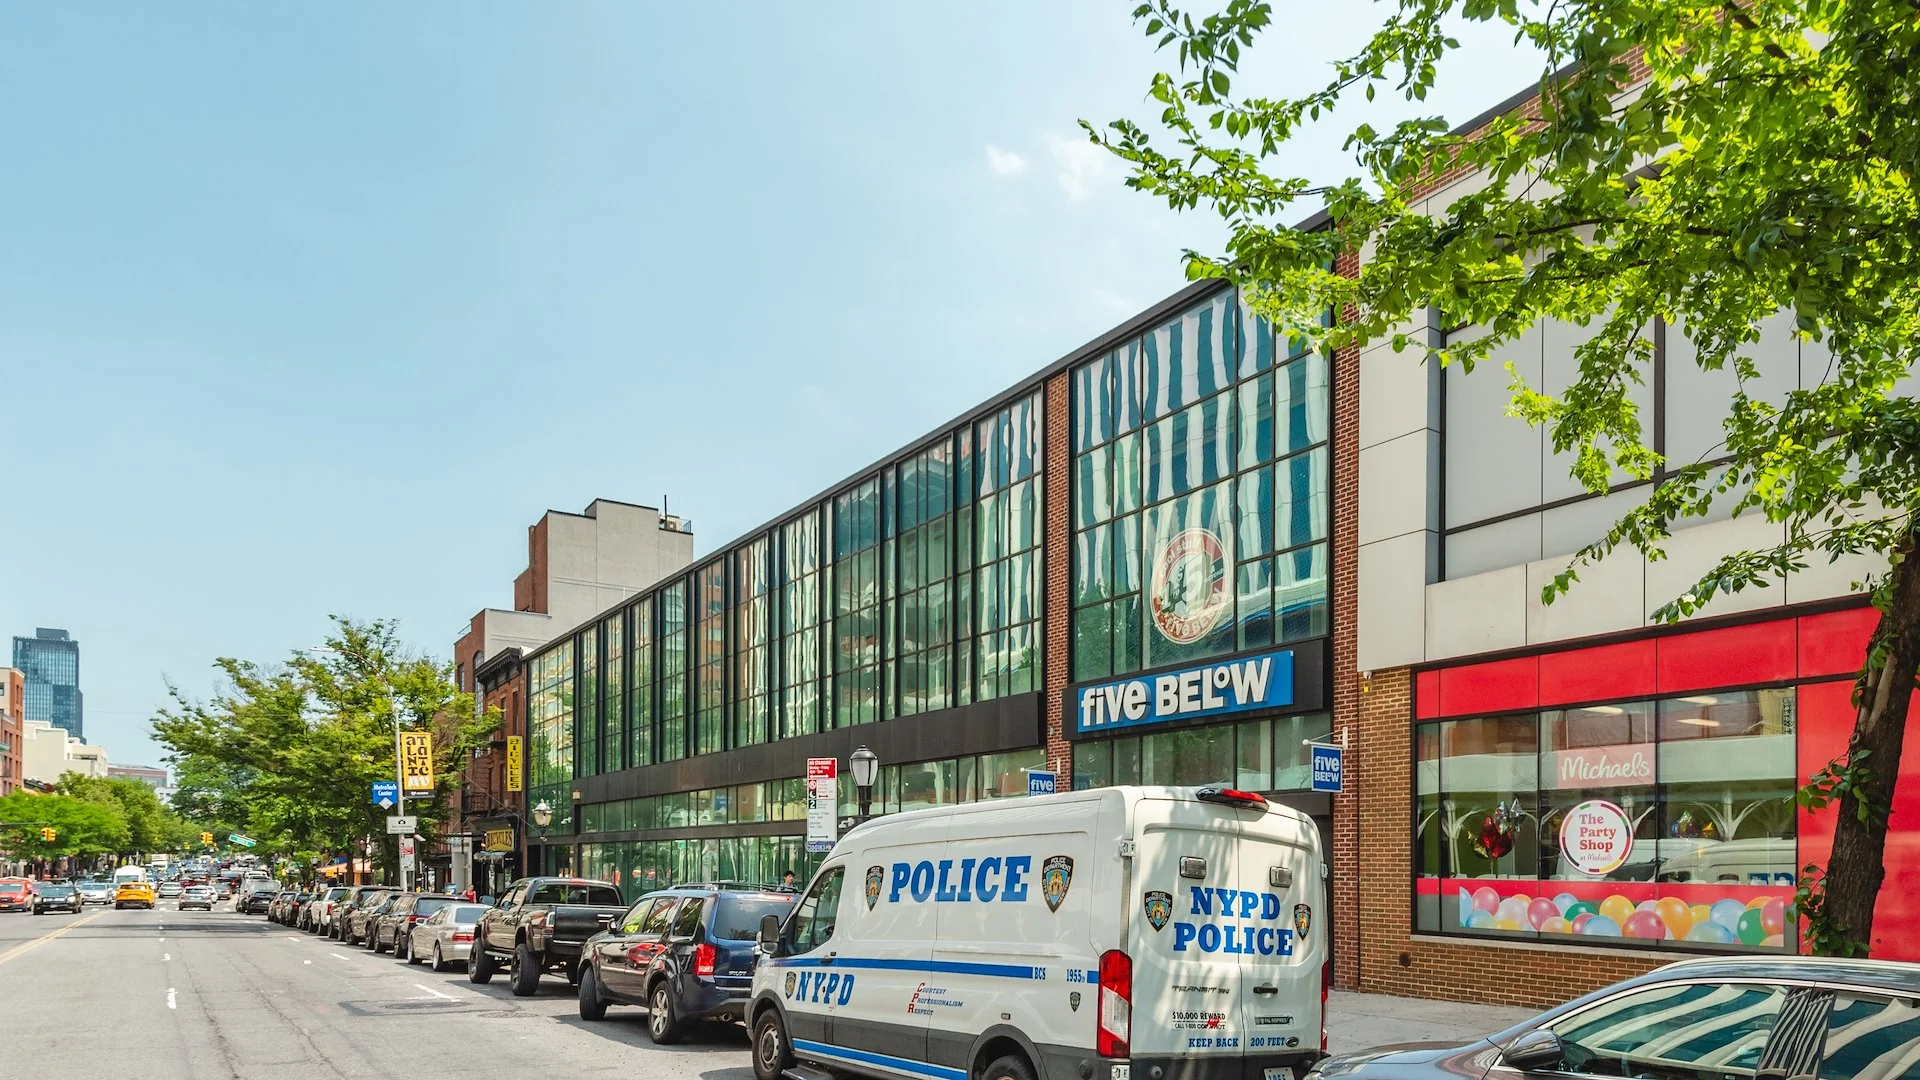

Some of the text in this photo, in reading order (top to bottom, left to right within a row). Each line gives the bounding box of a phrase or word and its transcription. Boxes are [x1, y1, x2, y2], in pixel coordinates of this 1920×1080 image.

[1081, 657, 1272, 727] five BELOW
[1314, 755, 1340, 772] five
[1561, 752, 1650, 781] Michaels
[1314, 771, 1340, 783] BELOW
[1031, 779, 1054, 791] five
[1579, 814, 1604, 825] The
[1580, 827, 1616, 839] Party
[1580, 839, 1613, 852] Shop
[888, 856, 1032, 903] POLICE
[1190, 886, 1281, 921] NYPD
[1173, 922, 1293, 956] POLICE
[1034, 967, 1046, 980] BCS
[1066, 969, 1081, 983] 1955
[795, 971, 854, 1006] NYPD
[1172, 985, 1217, 993] TRANSIT
[911, 993, 963, 1007] PROFESSIONALISM
[908, 1004, 934, 1016] RESPECT
[1188, 1037, 1286, 1047] KEEP BACK 200 FEET
